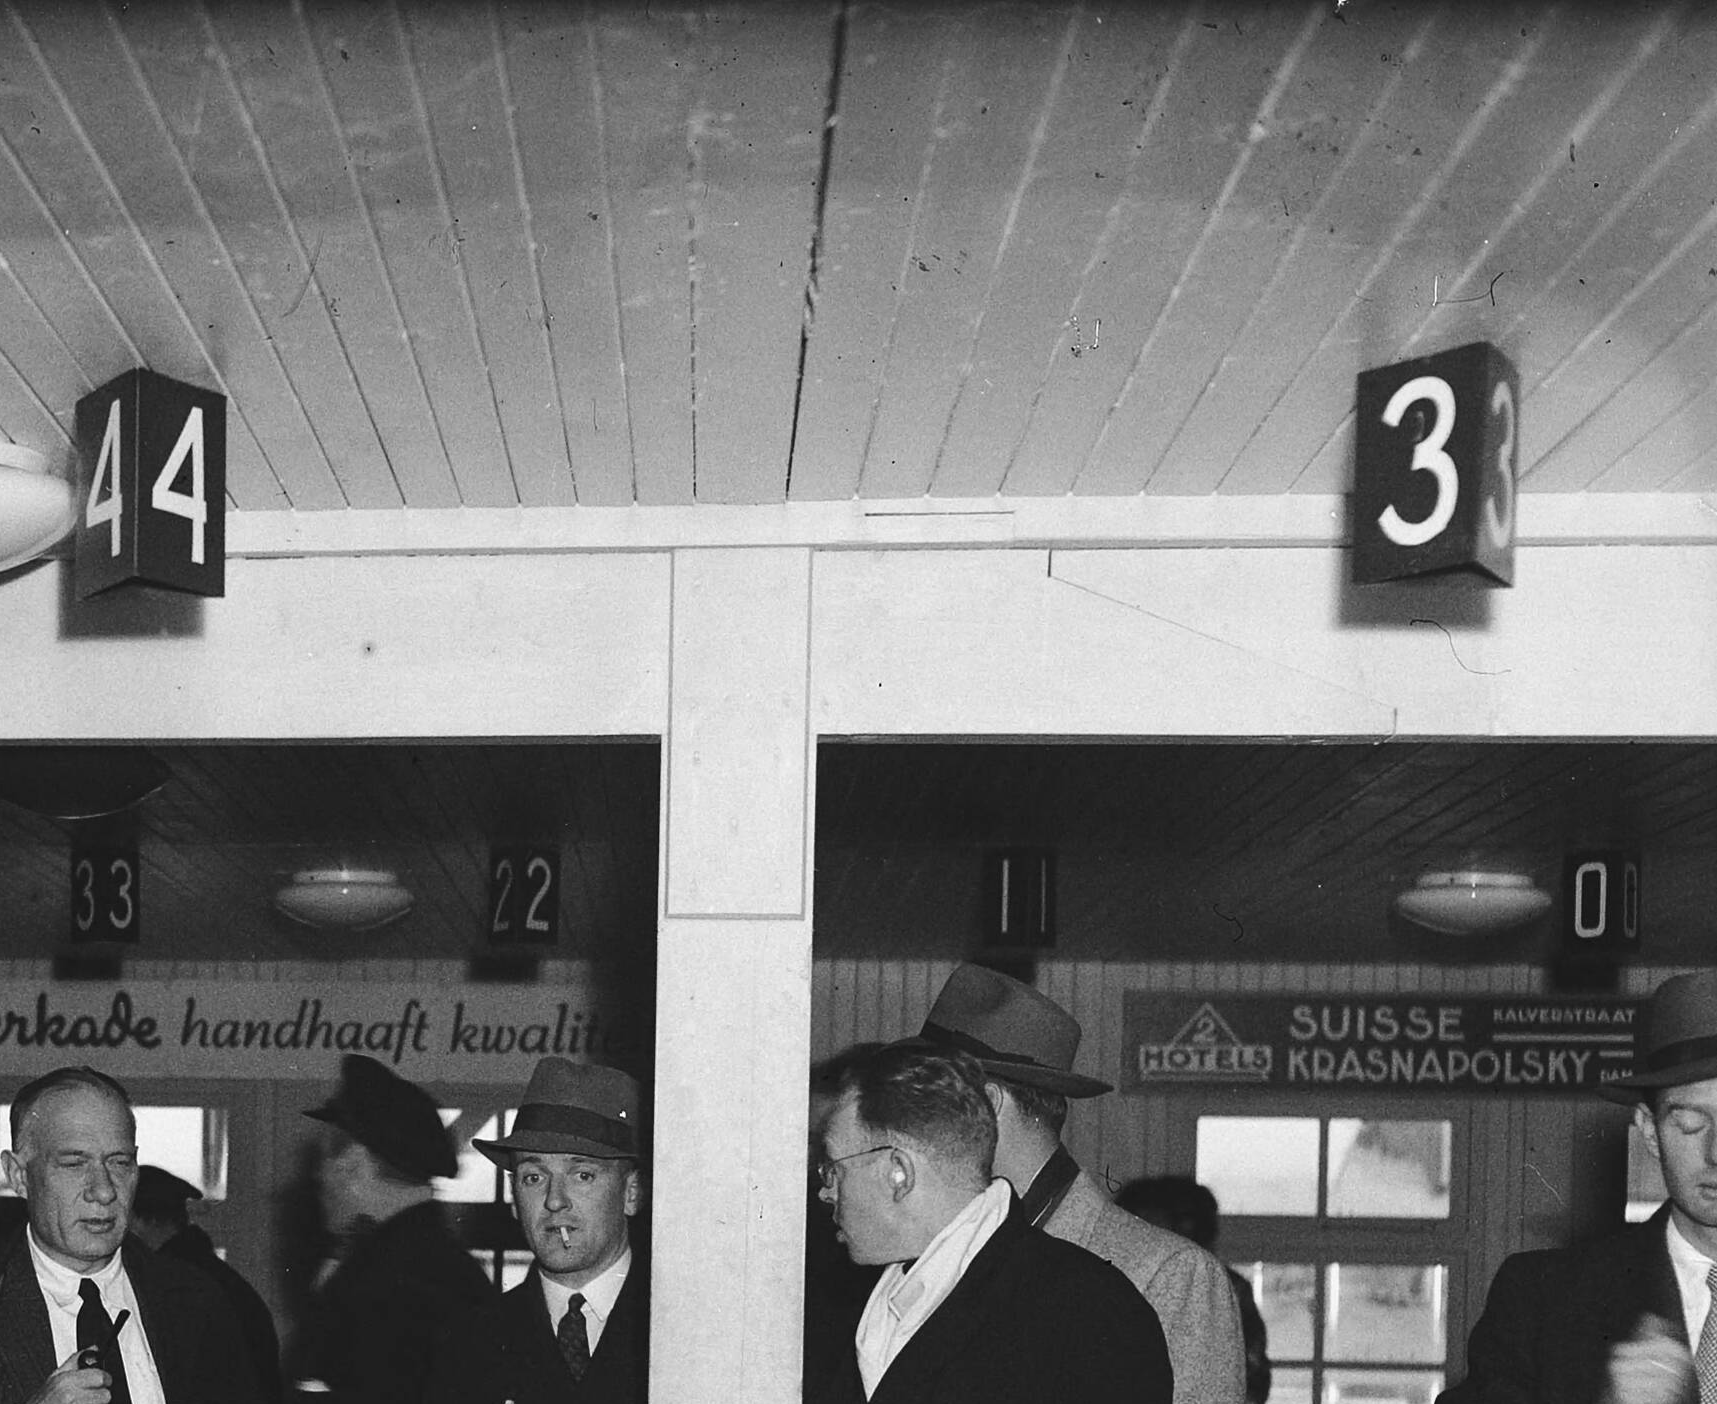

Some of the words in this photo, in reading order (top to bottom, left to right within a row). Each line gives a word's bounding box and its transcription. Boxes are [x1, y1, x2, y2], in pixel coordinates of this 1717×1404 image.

[86, 398, 122, 557] 4
[152, 406, 208, 565] 4
[1378, 376, 1459, 546] 3
[1486, 381, 1514, 549] 3
[109, 859, 133, 930] 3
[526, 857, 551, 931] 2
[179, 998, 431, 1064] handhaaft
[449, 999, 602, 1055] kwalit
[1143, 1048, 1270, 1070] HOTELS
[1192, 1017, 1217, 1042] 2
[1289, 1005, 1465, 1043] SUISSE
[1492, 1007, 1636, 1024] KALVERSTRAAT
[1288, 1048, 1591, 1084] KRASNAPOLSKY
